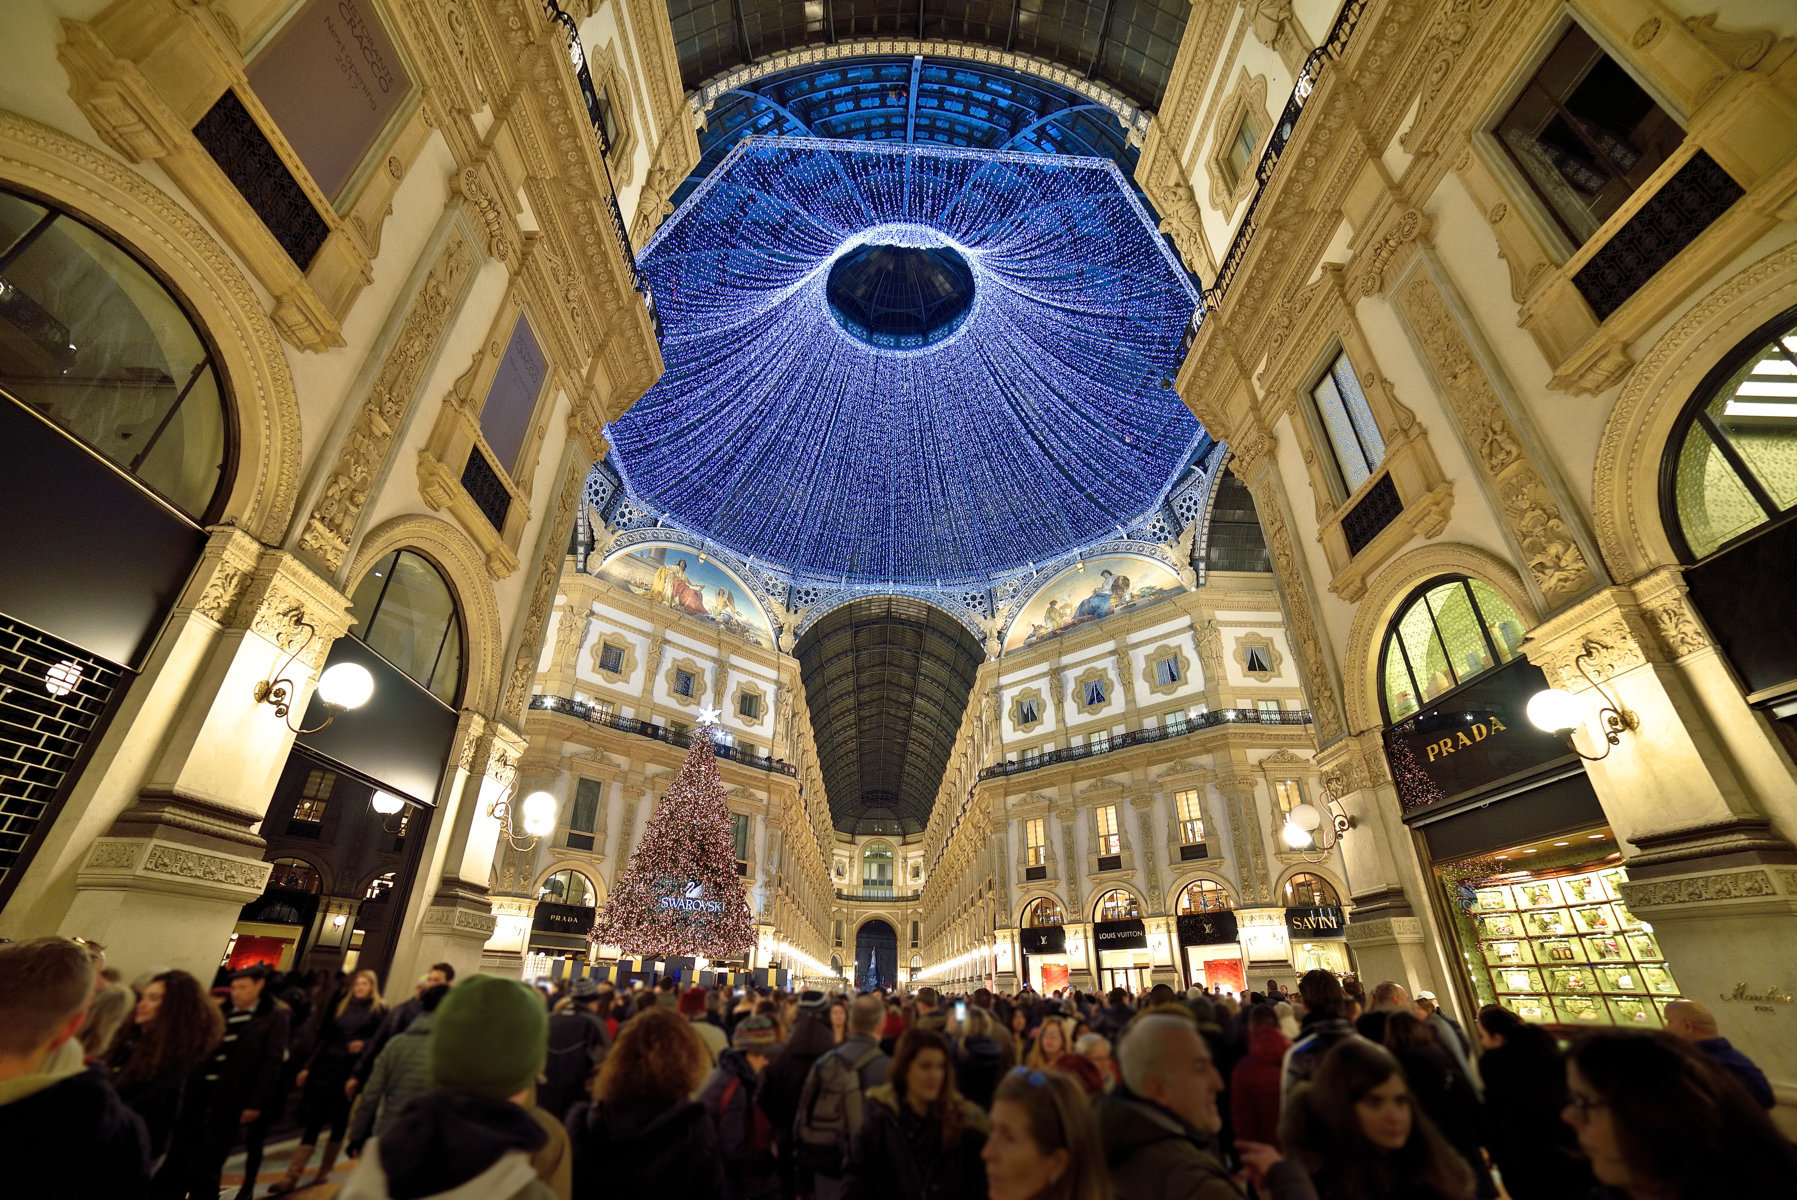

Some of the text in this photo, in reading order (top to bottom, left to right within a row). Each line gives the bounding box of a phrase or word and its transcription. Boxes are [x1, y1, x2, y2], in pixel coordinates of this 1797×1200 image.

[339, 2, 389, 93] CRACCO
[325, 16, 377, 111] Next opening
[1426, 716, 1507, 762] PRADA
[661, 897, 725, 912] SWAROVSKI
[550, 915, 578, 923] PRADA
[1292, 916, 1338, 930] SAVINI
[1099, 930, 1143, 940] LOUIS VUITTON
